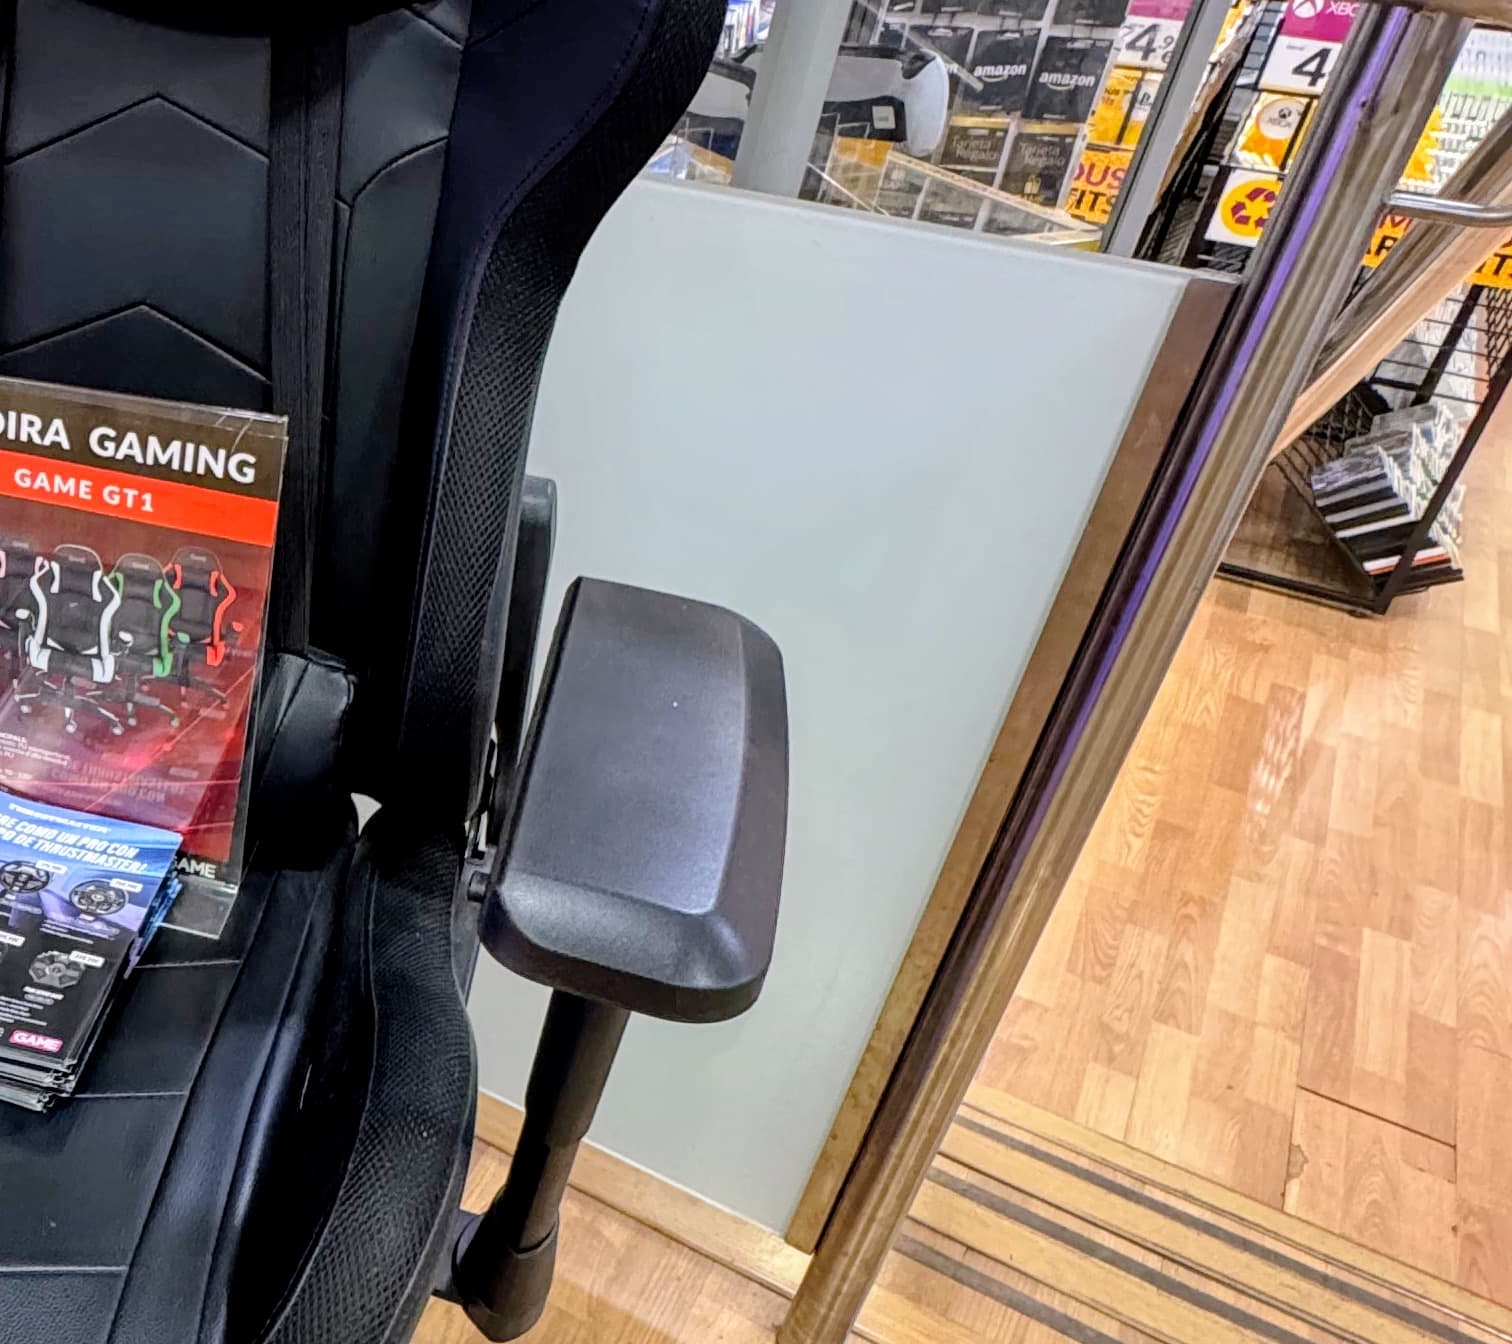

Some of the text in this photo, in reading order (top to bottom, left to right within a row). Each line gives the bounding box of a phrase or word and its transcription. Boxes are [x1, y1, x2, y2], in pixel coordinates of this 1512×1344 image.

[973, 60, 1028, 80] amazon
[1038, 69, 1096, 89] amazon
[88, 425, 257, 485] GAMING
[13, 467, 155, 513] GAME GT1
[13, 831, 35, 848] DE
[32, 837, 150, 873] THRUSTMASTER!
[16, 820, 58, 840] COMO
[80, 835, 108, 854] PRO
[106, 841, 140, 859] CON
[13, 1032, 60, 1051] GAME
